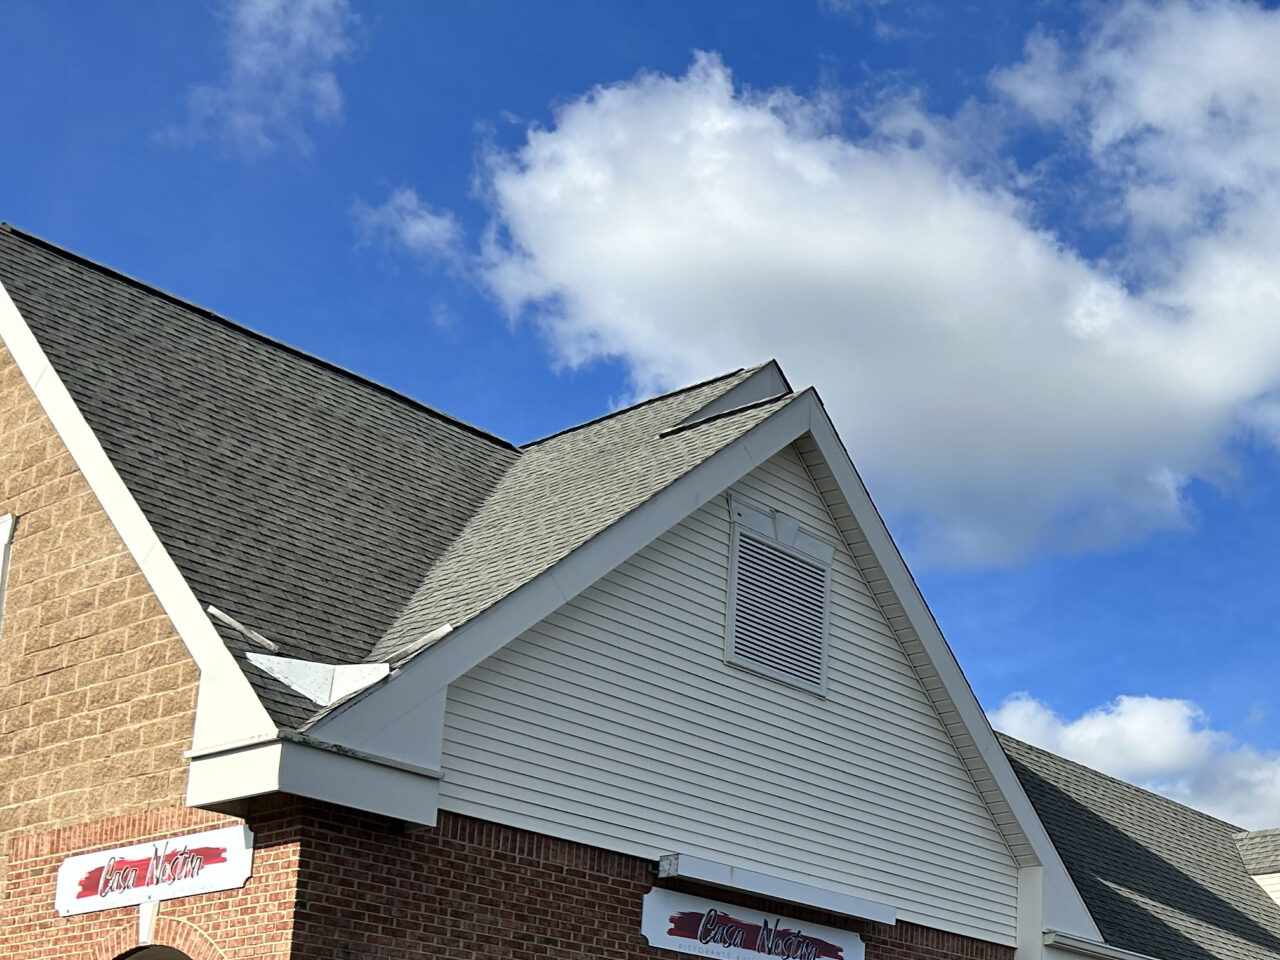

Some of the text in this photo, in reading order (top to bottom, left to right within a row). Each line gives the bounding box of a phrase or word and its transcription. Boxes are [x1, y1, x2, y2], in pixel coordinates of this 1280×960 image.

[98, 857, 138, 897] Casa
[145, 841, 203, 887] Nostra
[698, 908, 746, 949] Casa
